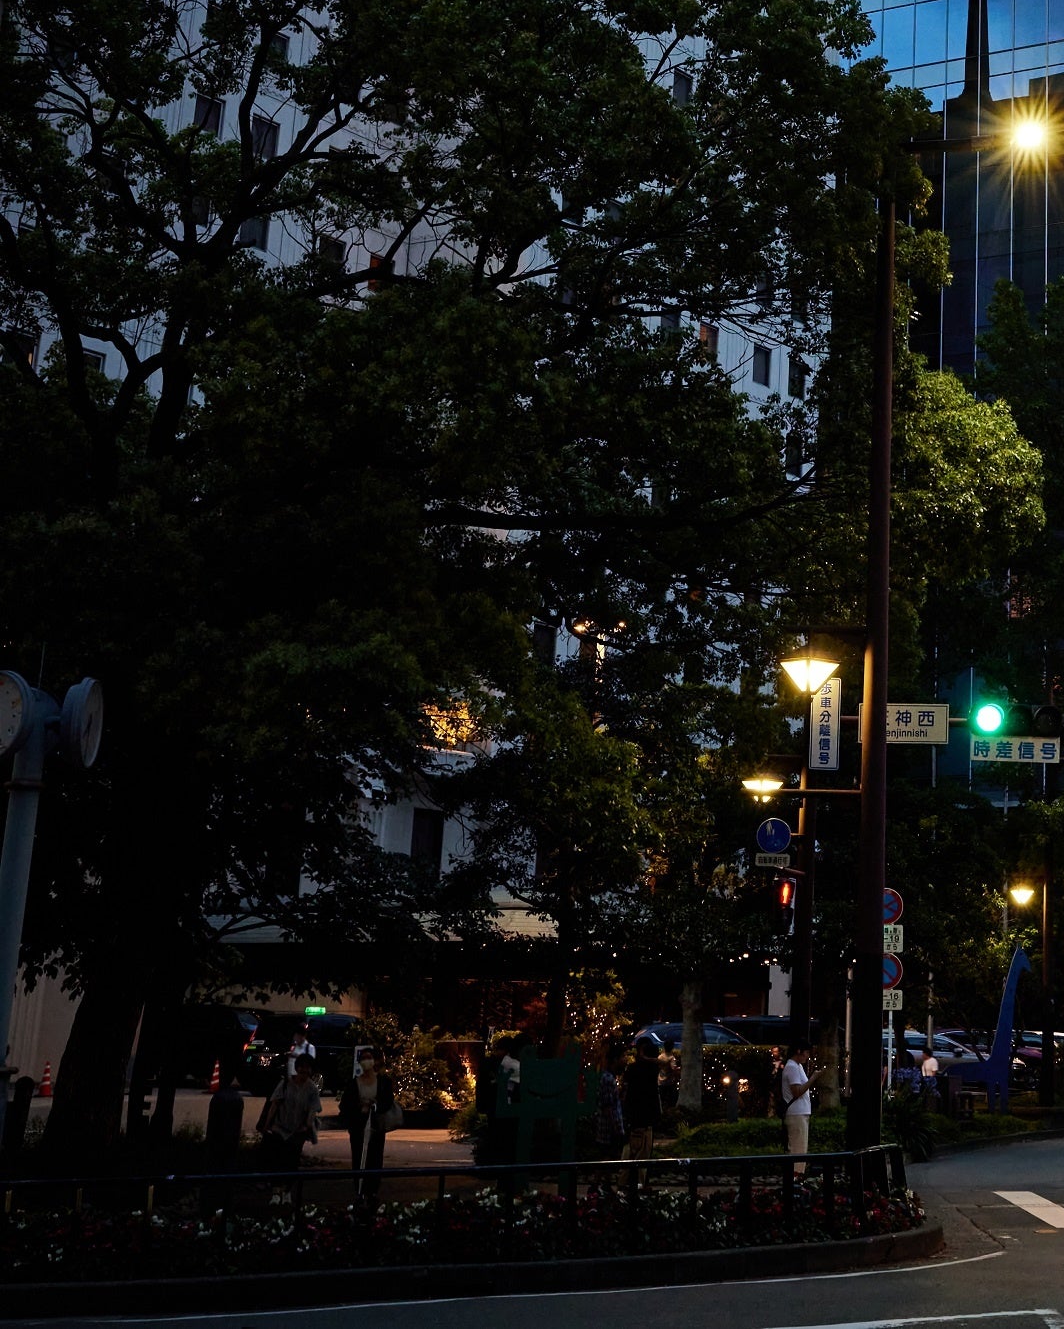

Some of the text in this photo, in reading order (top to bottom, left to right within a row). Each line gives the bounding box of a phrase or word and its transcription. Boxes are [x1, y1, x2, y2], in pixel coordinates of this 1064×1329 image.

[886, 709, 936, 728] 神西
[886, 728, 928, 739] enjinnishi
[973, 740, 1058, 760] 時差信号
